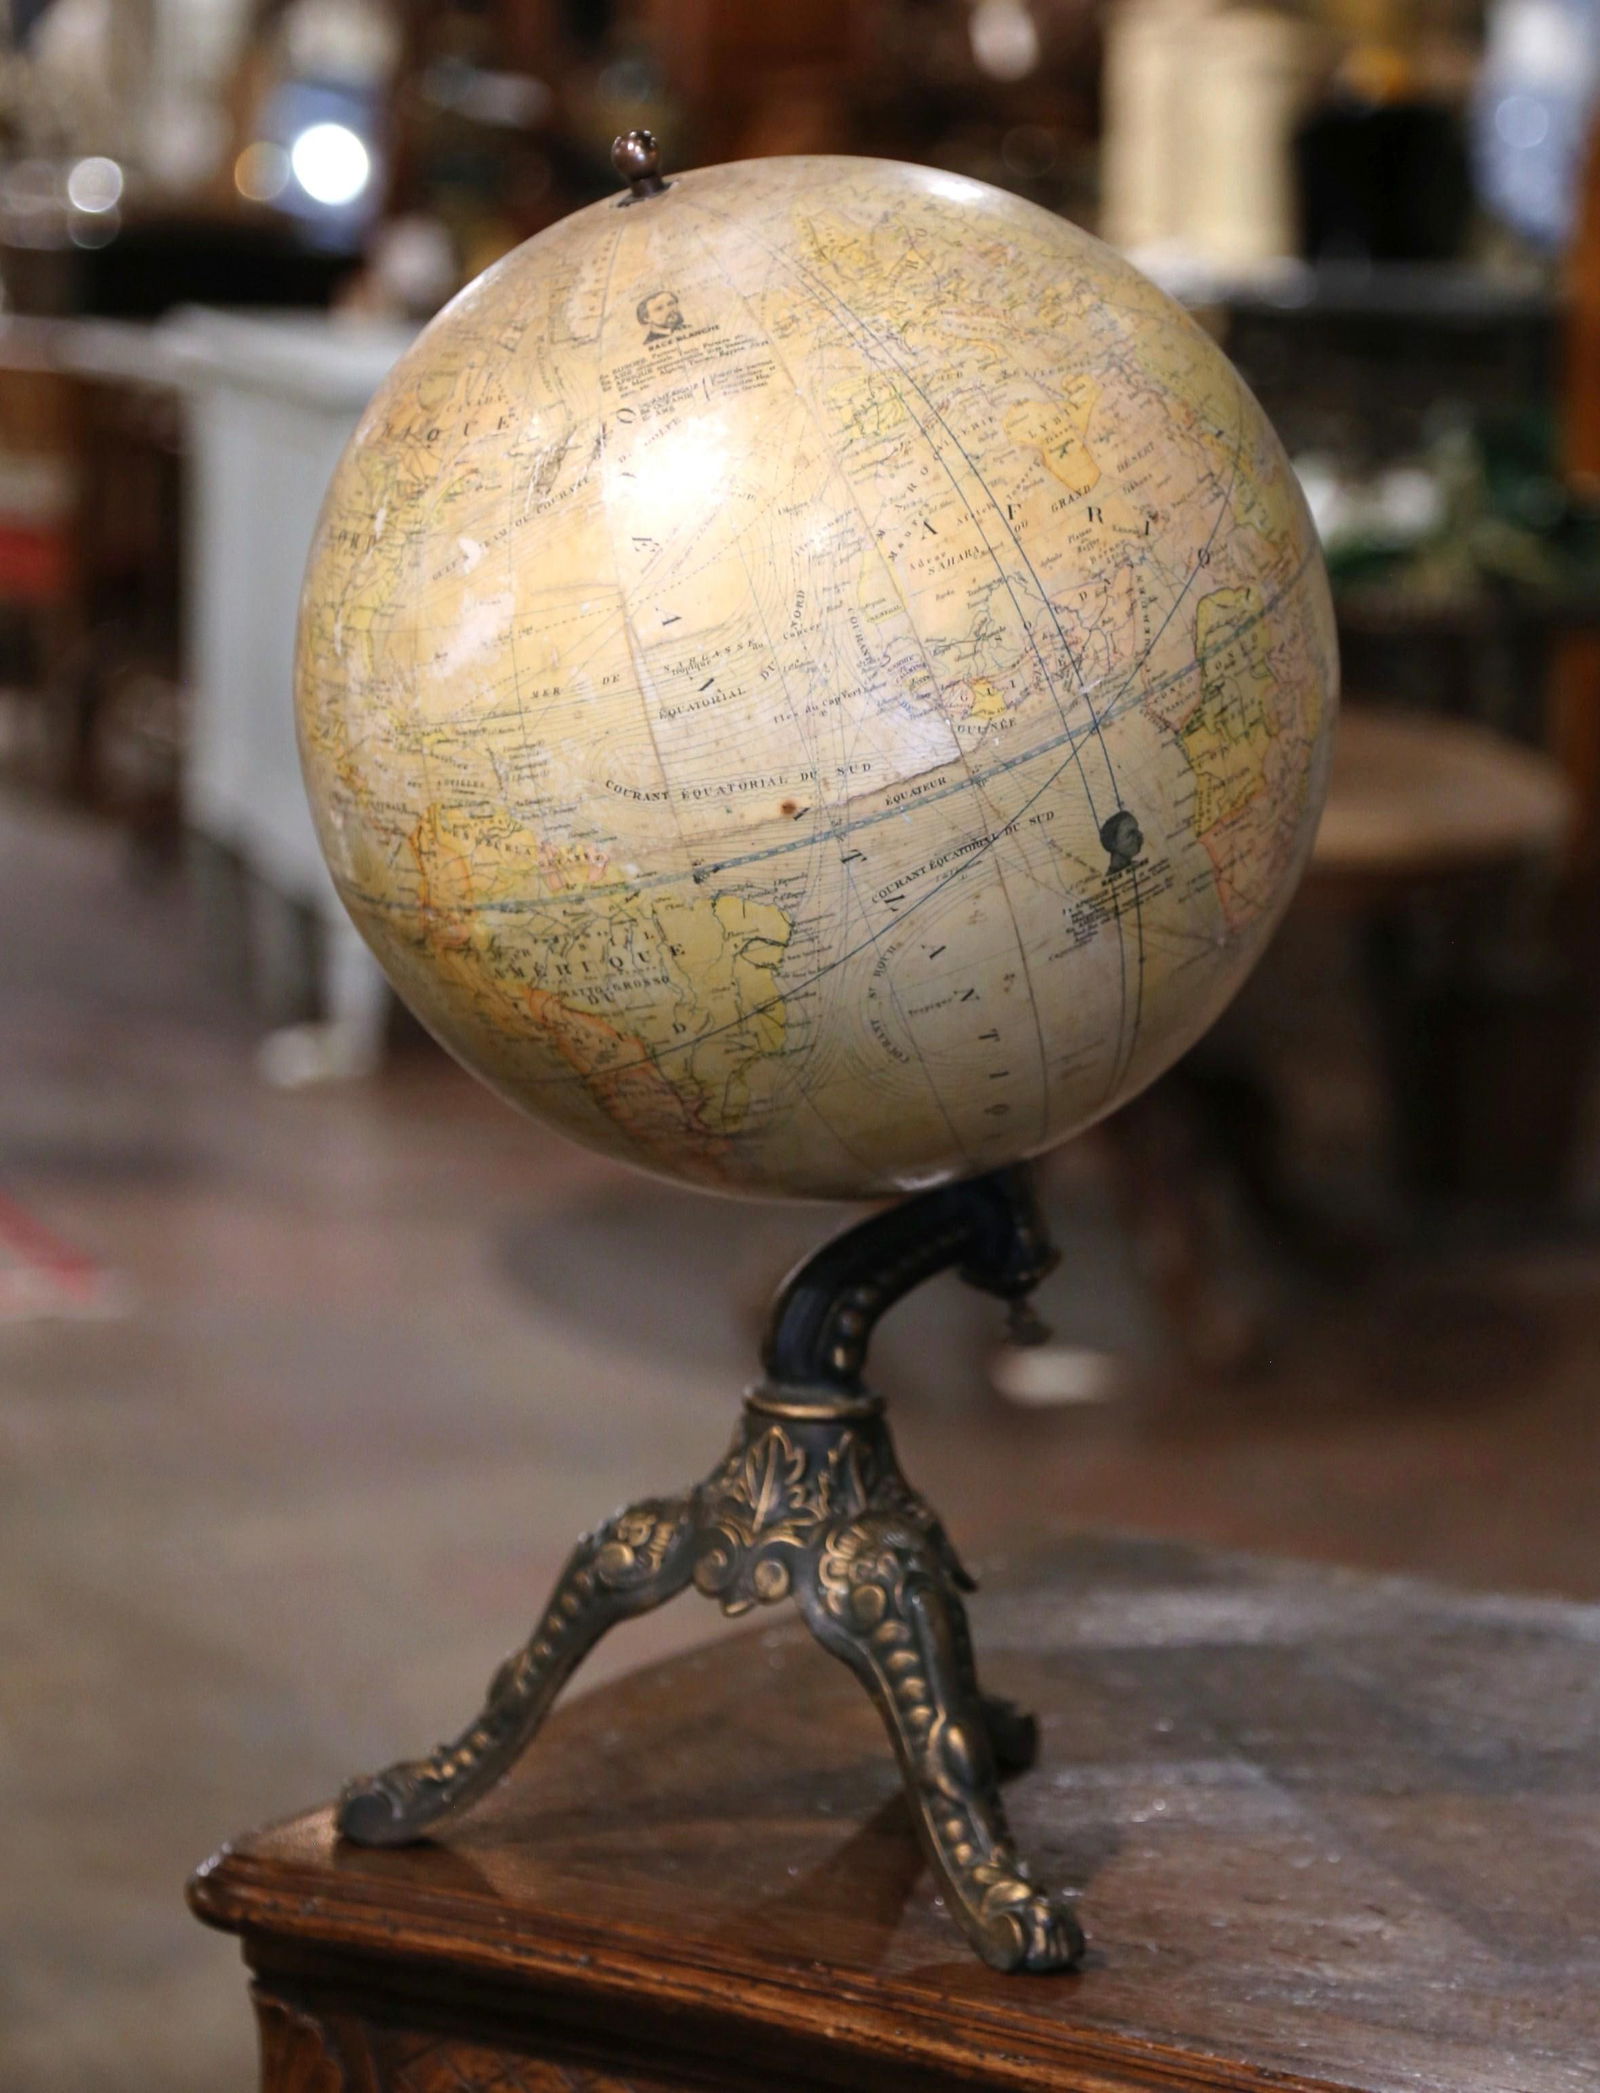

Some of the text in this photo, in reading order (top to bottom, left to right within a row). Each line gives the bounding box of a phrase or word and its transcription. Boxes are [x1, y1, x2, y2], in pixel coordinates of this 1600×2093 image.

[604, 779, 670, 802] COURANT
[681, 775, 789, 801] ÉQUATORIAL
[837, 762, 873, 777] SUD
[884, 776, 948, 807] ÉQUATEUR
[871, 866, 927, 905] COURANT
[1028, 810, 1056, 826] SUD
